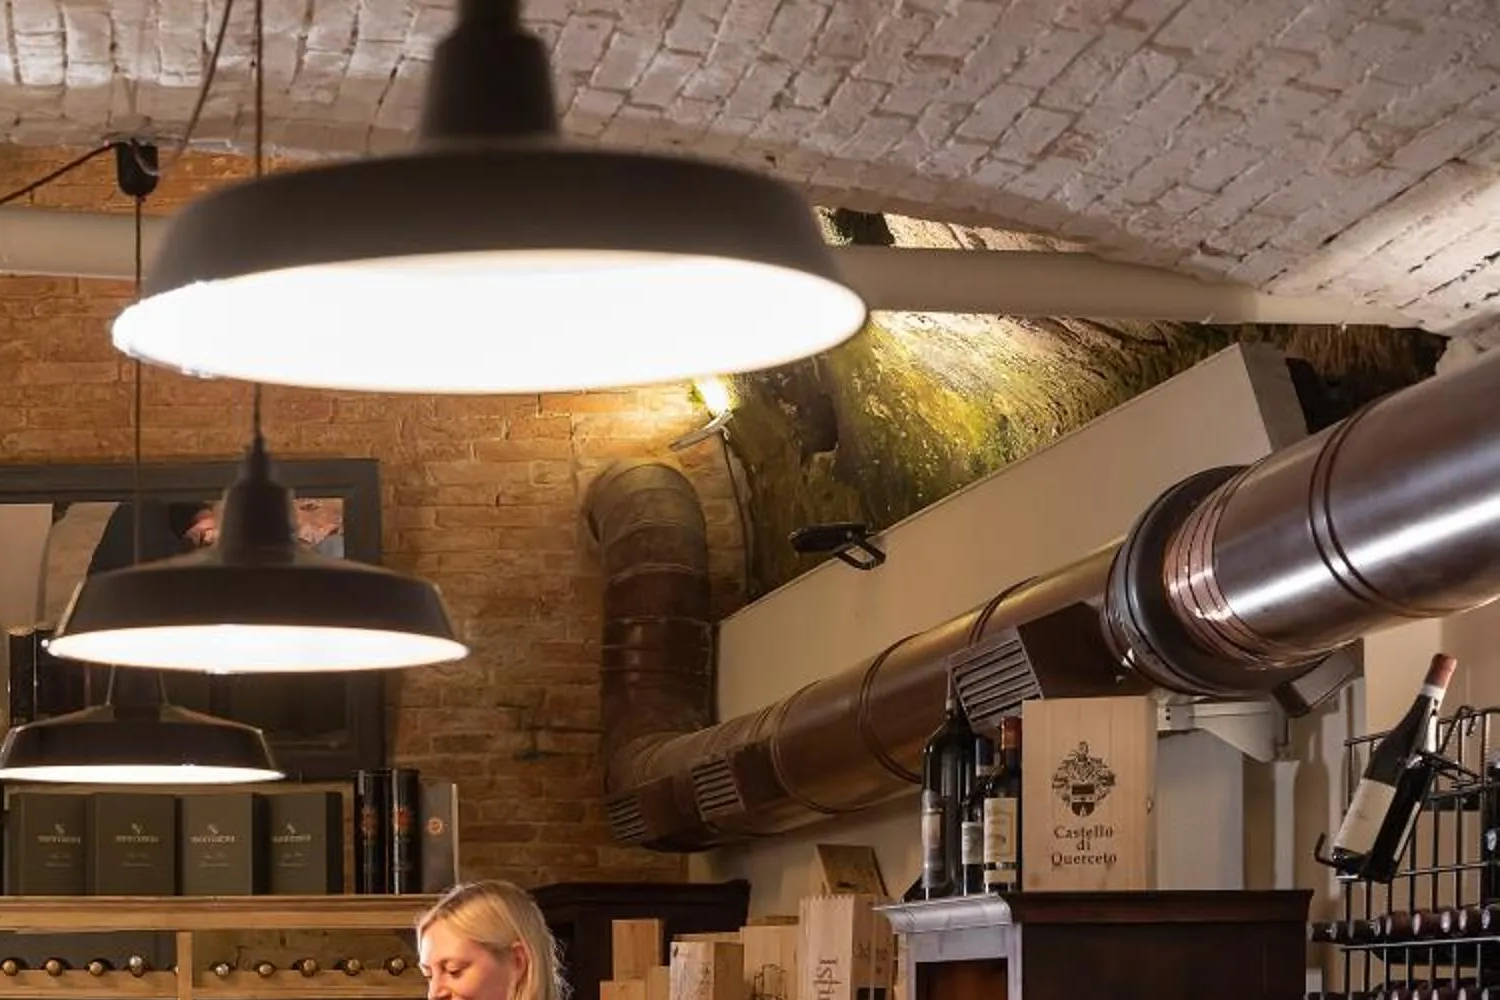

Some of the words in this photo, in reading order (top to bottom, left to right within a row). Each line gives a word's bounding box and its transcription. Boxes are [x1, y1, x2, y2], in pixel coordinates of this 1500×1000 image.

[1053, 825, 1114, 840] Castello
[1076, 839, 1092, 852] di
[1051, 852, 1118, 869] Querceto
